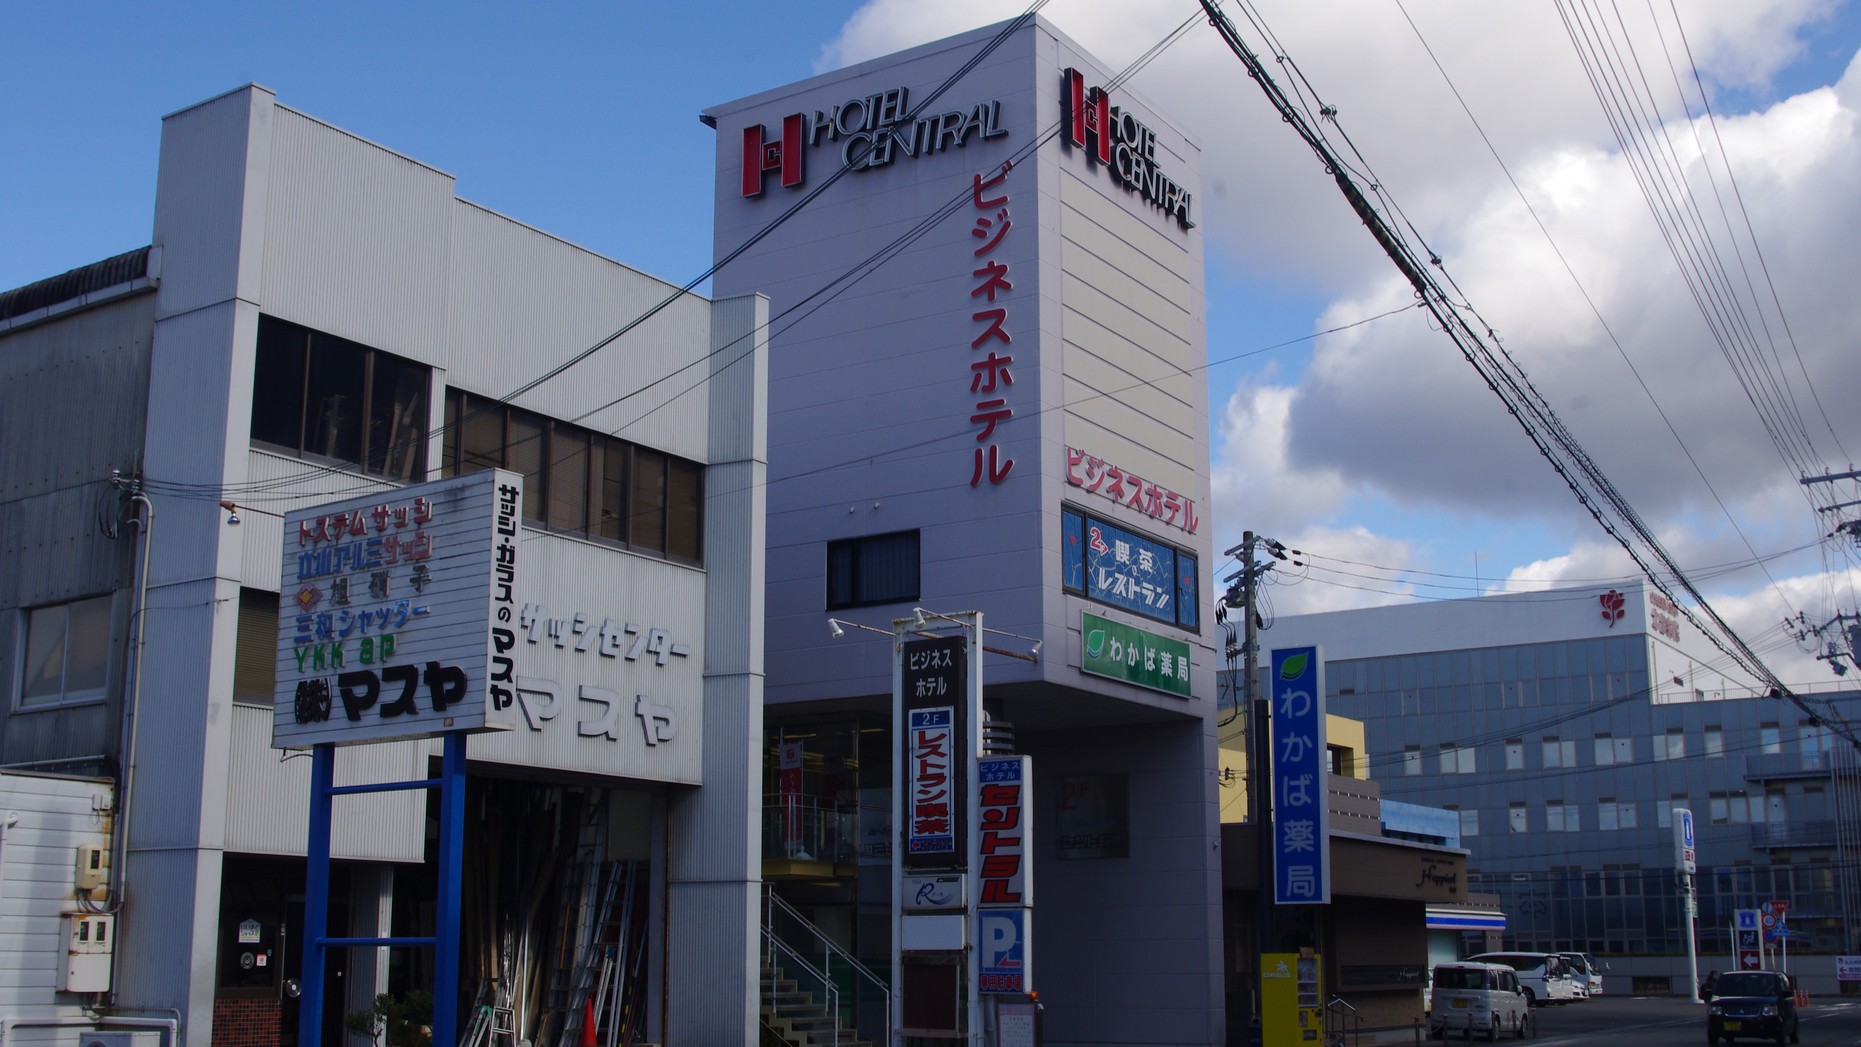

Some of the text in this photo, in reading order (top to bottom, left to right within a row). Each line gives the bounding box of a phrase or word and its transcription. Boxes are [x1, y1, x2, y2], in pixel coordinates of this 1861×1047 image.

[810, 86, 911, 146] HOTEL
[842, 99, 1008, 171] CENTRAL
[1115, 142, 1196, 229] CENTRAL
[971, 160, 1014, 488] ビジネスホテル
[1065, 447, 1199, 533] ビジネスホテル
[1115, 539, 1154, 574] 喫茶
[489, 484, 519, 711] サッシ・ガラスのマスヤ
[1098, 567, 1169, 609] レストラン
[294, 599, 430, 643] 三和シャッター
[521, 603, 690, 667] サッシセンター
[294, 634, 397, 673] YKK ap
[910, 648, 952, 671] ビジネス
[1110, 636, 1189, 682] わかば薬局
[516, 675, 679, 747] マスヤ
[916, 676, 947, 698] ホテル
[922, 712, 940, 726] 2F
[916, 730, 949, 834] レストラン喫茶
[980, 761, 1020, 773] ビジネス
[986, 771, 1016, 781] ホテル
[1280, 687, 1316, 897] わかば薬局
[980, 783, 1021, 904] セントラル
[980, 917, 1018, 968] P
